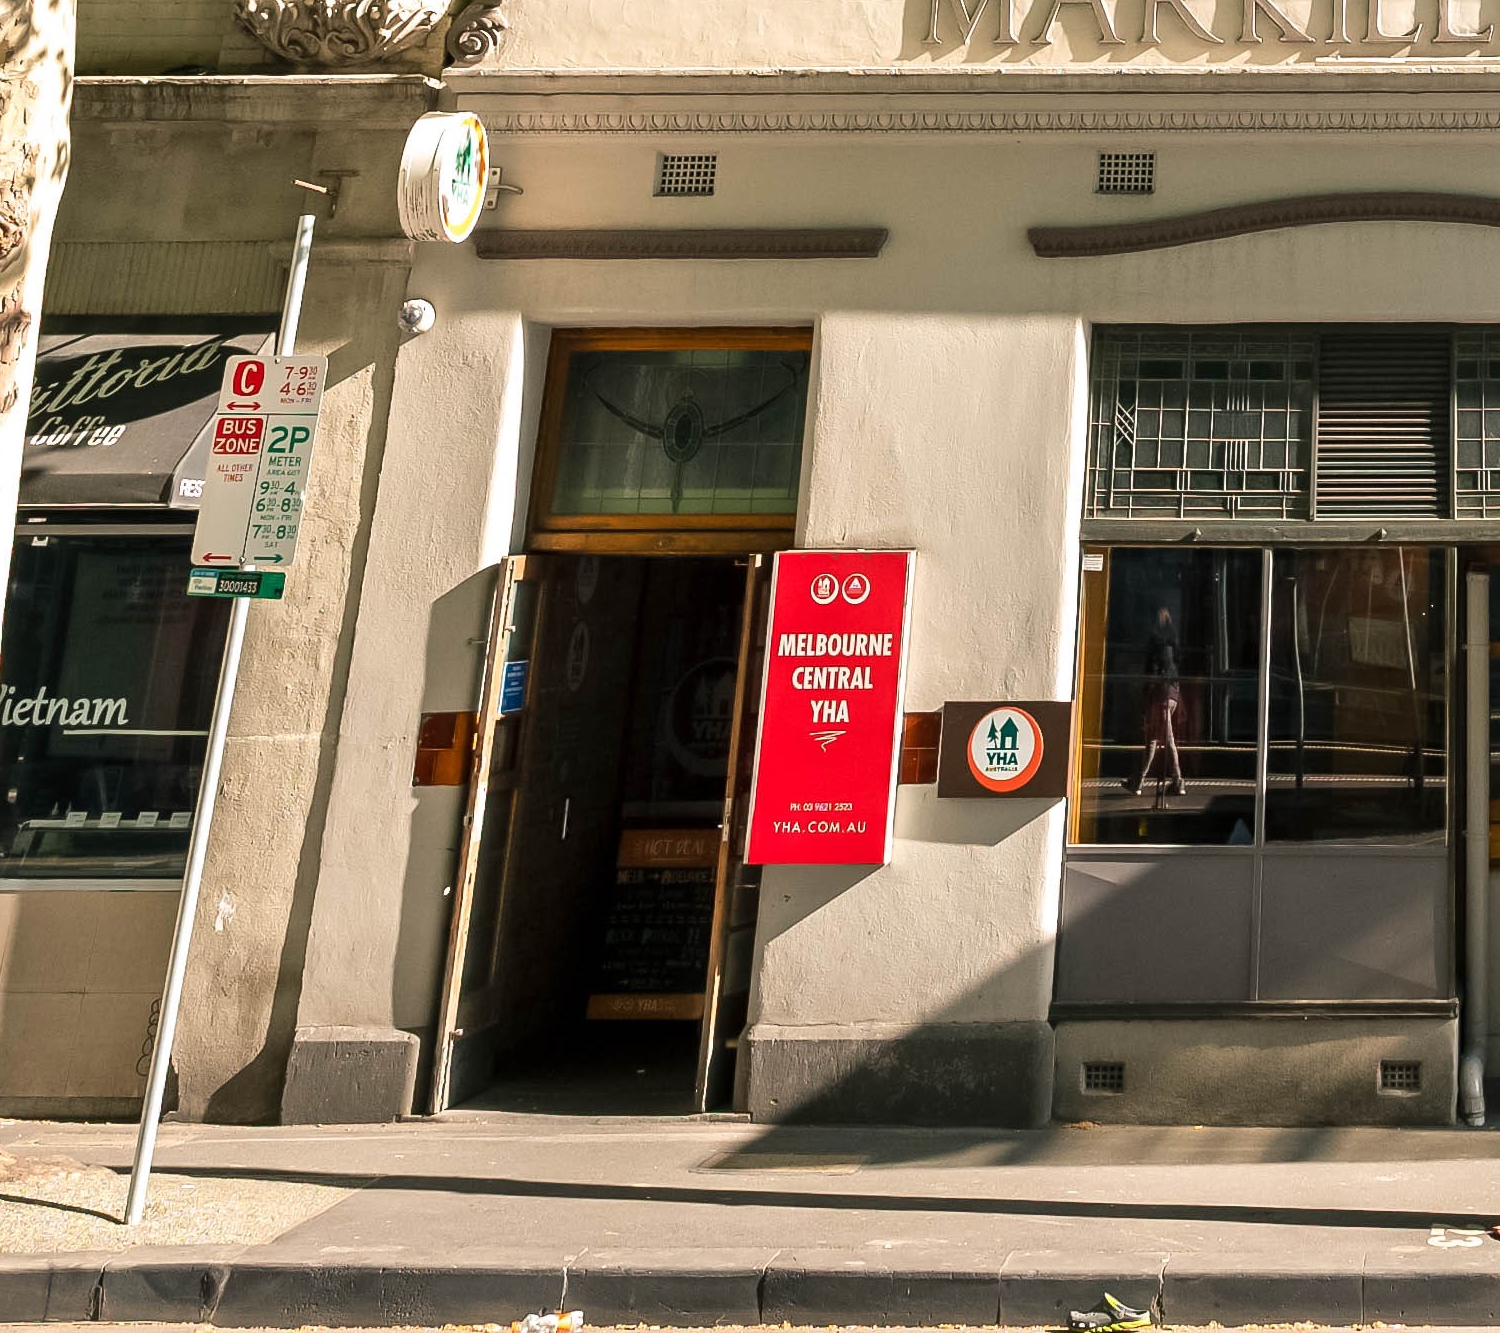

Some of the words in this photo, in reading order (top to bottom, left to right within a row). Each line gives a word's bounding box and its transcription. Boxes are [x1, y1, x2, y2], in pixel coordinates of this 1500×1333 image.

[241, 363, 258, 395] C
[30, 415, 127, 446] Coffee
[222, 419, 257, 434] BUS
[213, 438, 260, 453] ZONE
[267, 425, 310, 454] 2P
[217, 464, 230, 472] ALL
[232, 463, 254, 472] OTHER
[268, 456, 302, 467] METER
[223, 474, 244, 483] TIMES
[218, 580, 258, 594] 30001433
[777, 632, 893, 657] MELBOURNE
[791, 666, 873, 690] CENTRAL
[810, 699, 850, 723] YHA
[986, 752, 1019, 766] YHA
[773, 820, 867, 834] YHA.COM.AU
